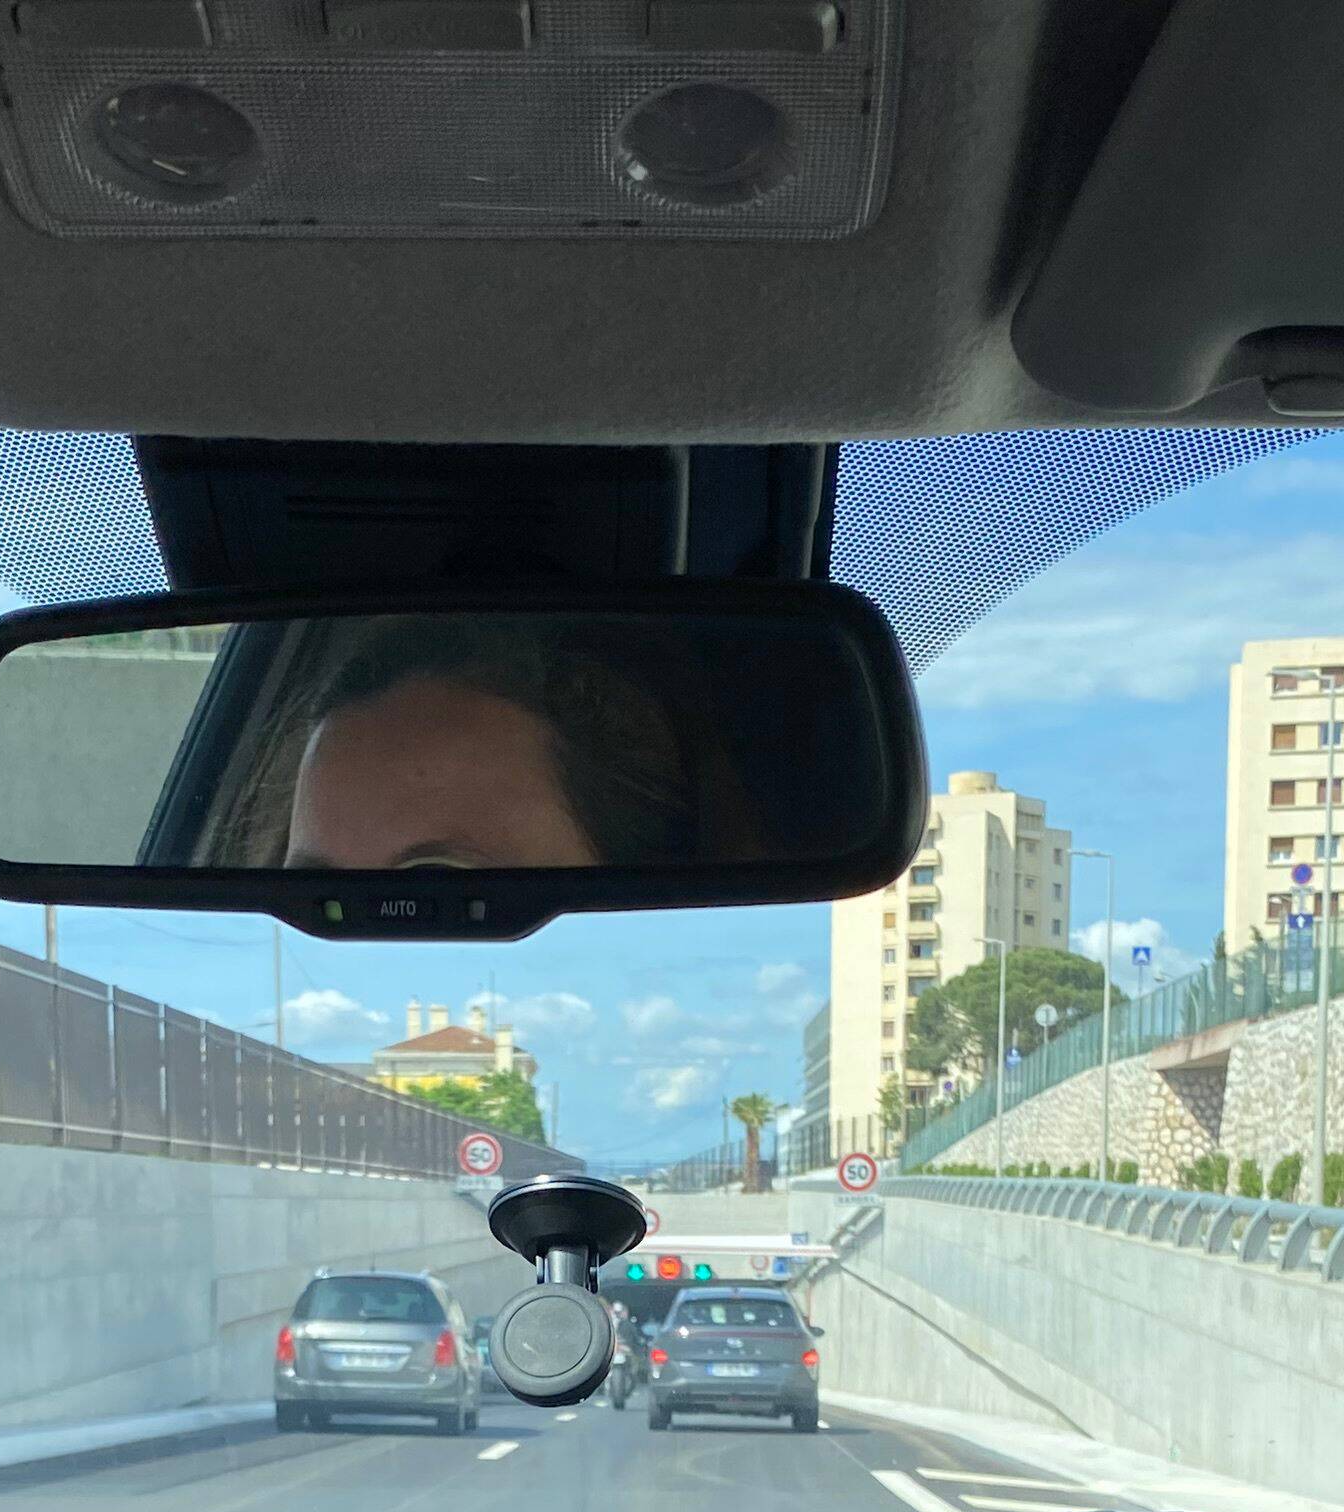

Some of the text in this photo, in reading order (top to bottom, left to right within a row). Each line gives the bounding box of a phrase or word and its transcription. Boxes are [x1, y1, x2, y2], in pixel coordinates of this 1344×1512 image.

[379, 900, 417, 917] AUTO
[467, 1147, 491, 1163] 50
[847, 1165, 869, 1180] 50
